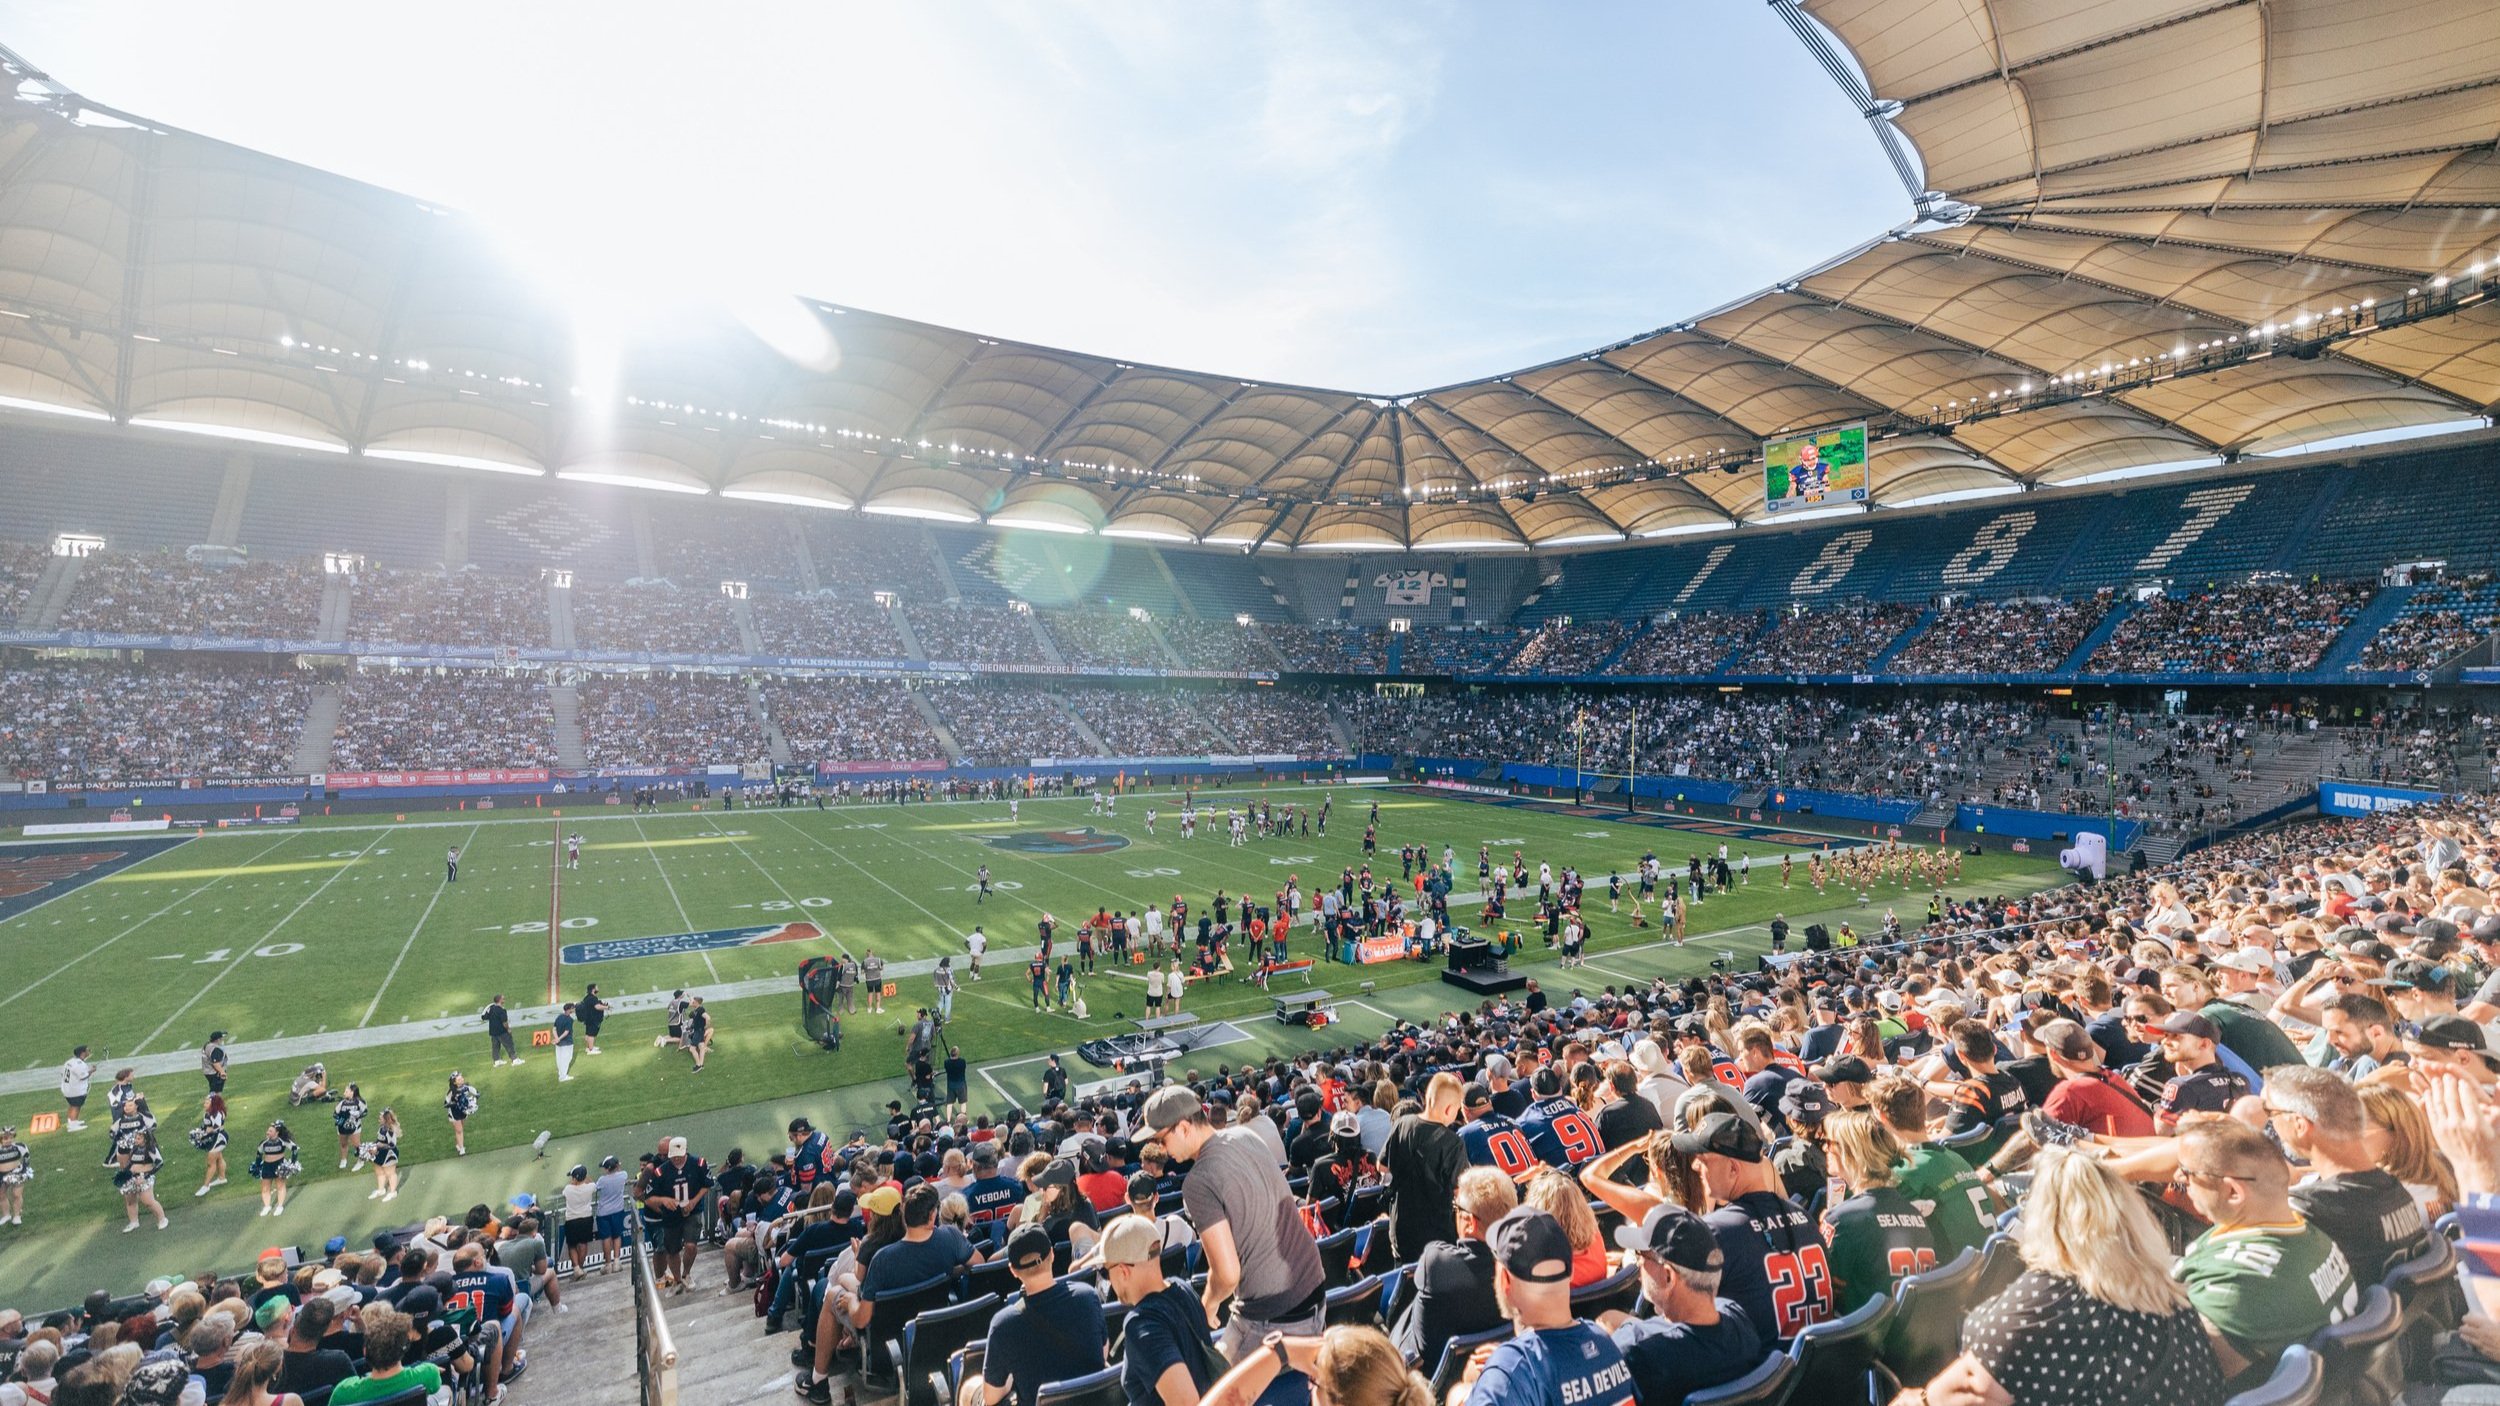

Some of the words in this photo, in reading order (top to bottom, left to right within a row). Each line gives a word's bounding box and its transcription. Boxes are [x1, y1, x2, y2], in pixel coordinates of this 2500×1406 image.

[790, 658, 894, 668] VOLKSPARKSTADION
[978, 663, 1083, 674] DIEONLINEDRUCKEREI.EU
[56, 782, 83, 790] GAME
[86, 781, 104, 790] DAY
[129, 779, 176, 788] ZUHAUSE!
[206, 777, 305, 786] SHOP.BLOCK-HOUSE.DE
[2334, 792, 2371, 810] NUR
[1125, 867, 1181, 878] 50
[759, 897, 833, 911] 30
[509, 917, 599, 934] 20
[193, 942, 306, 965] 10
[584, 943, 709, 960] FOOTBALL
[885, 984, 895, 995] 30
[535, 1032, 549, 1046] 20
[35, 1115, 54, 1132] 10
[672, 1183, 689, 1207] 11
[975, 1189, 1011, 1205] YEBOAH
[1777, 1210, 1809, 1227] DVILS
[1876, 1214, 1900, 1228] SEA
[1900, 1214, 1926, 1228] DEVILS
[1764, 1243, 1834, 1340] 23
[1561, 1376, 1593, 1406] SEA
[1593, 1359, 1632, 1395] DEVILS
